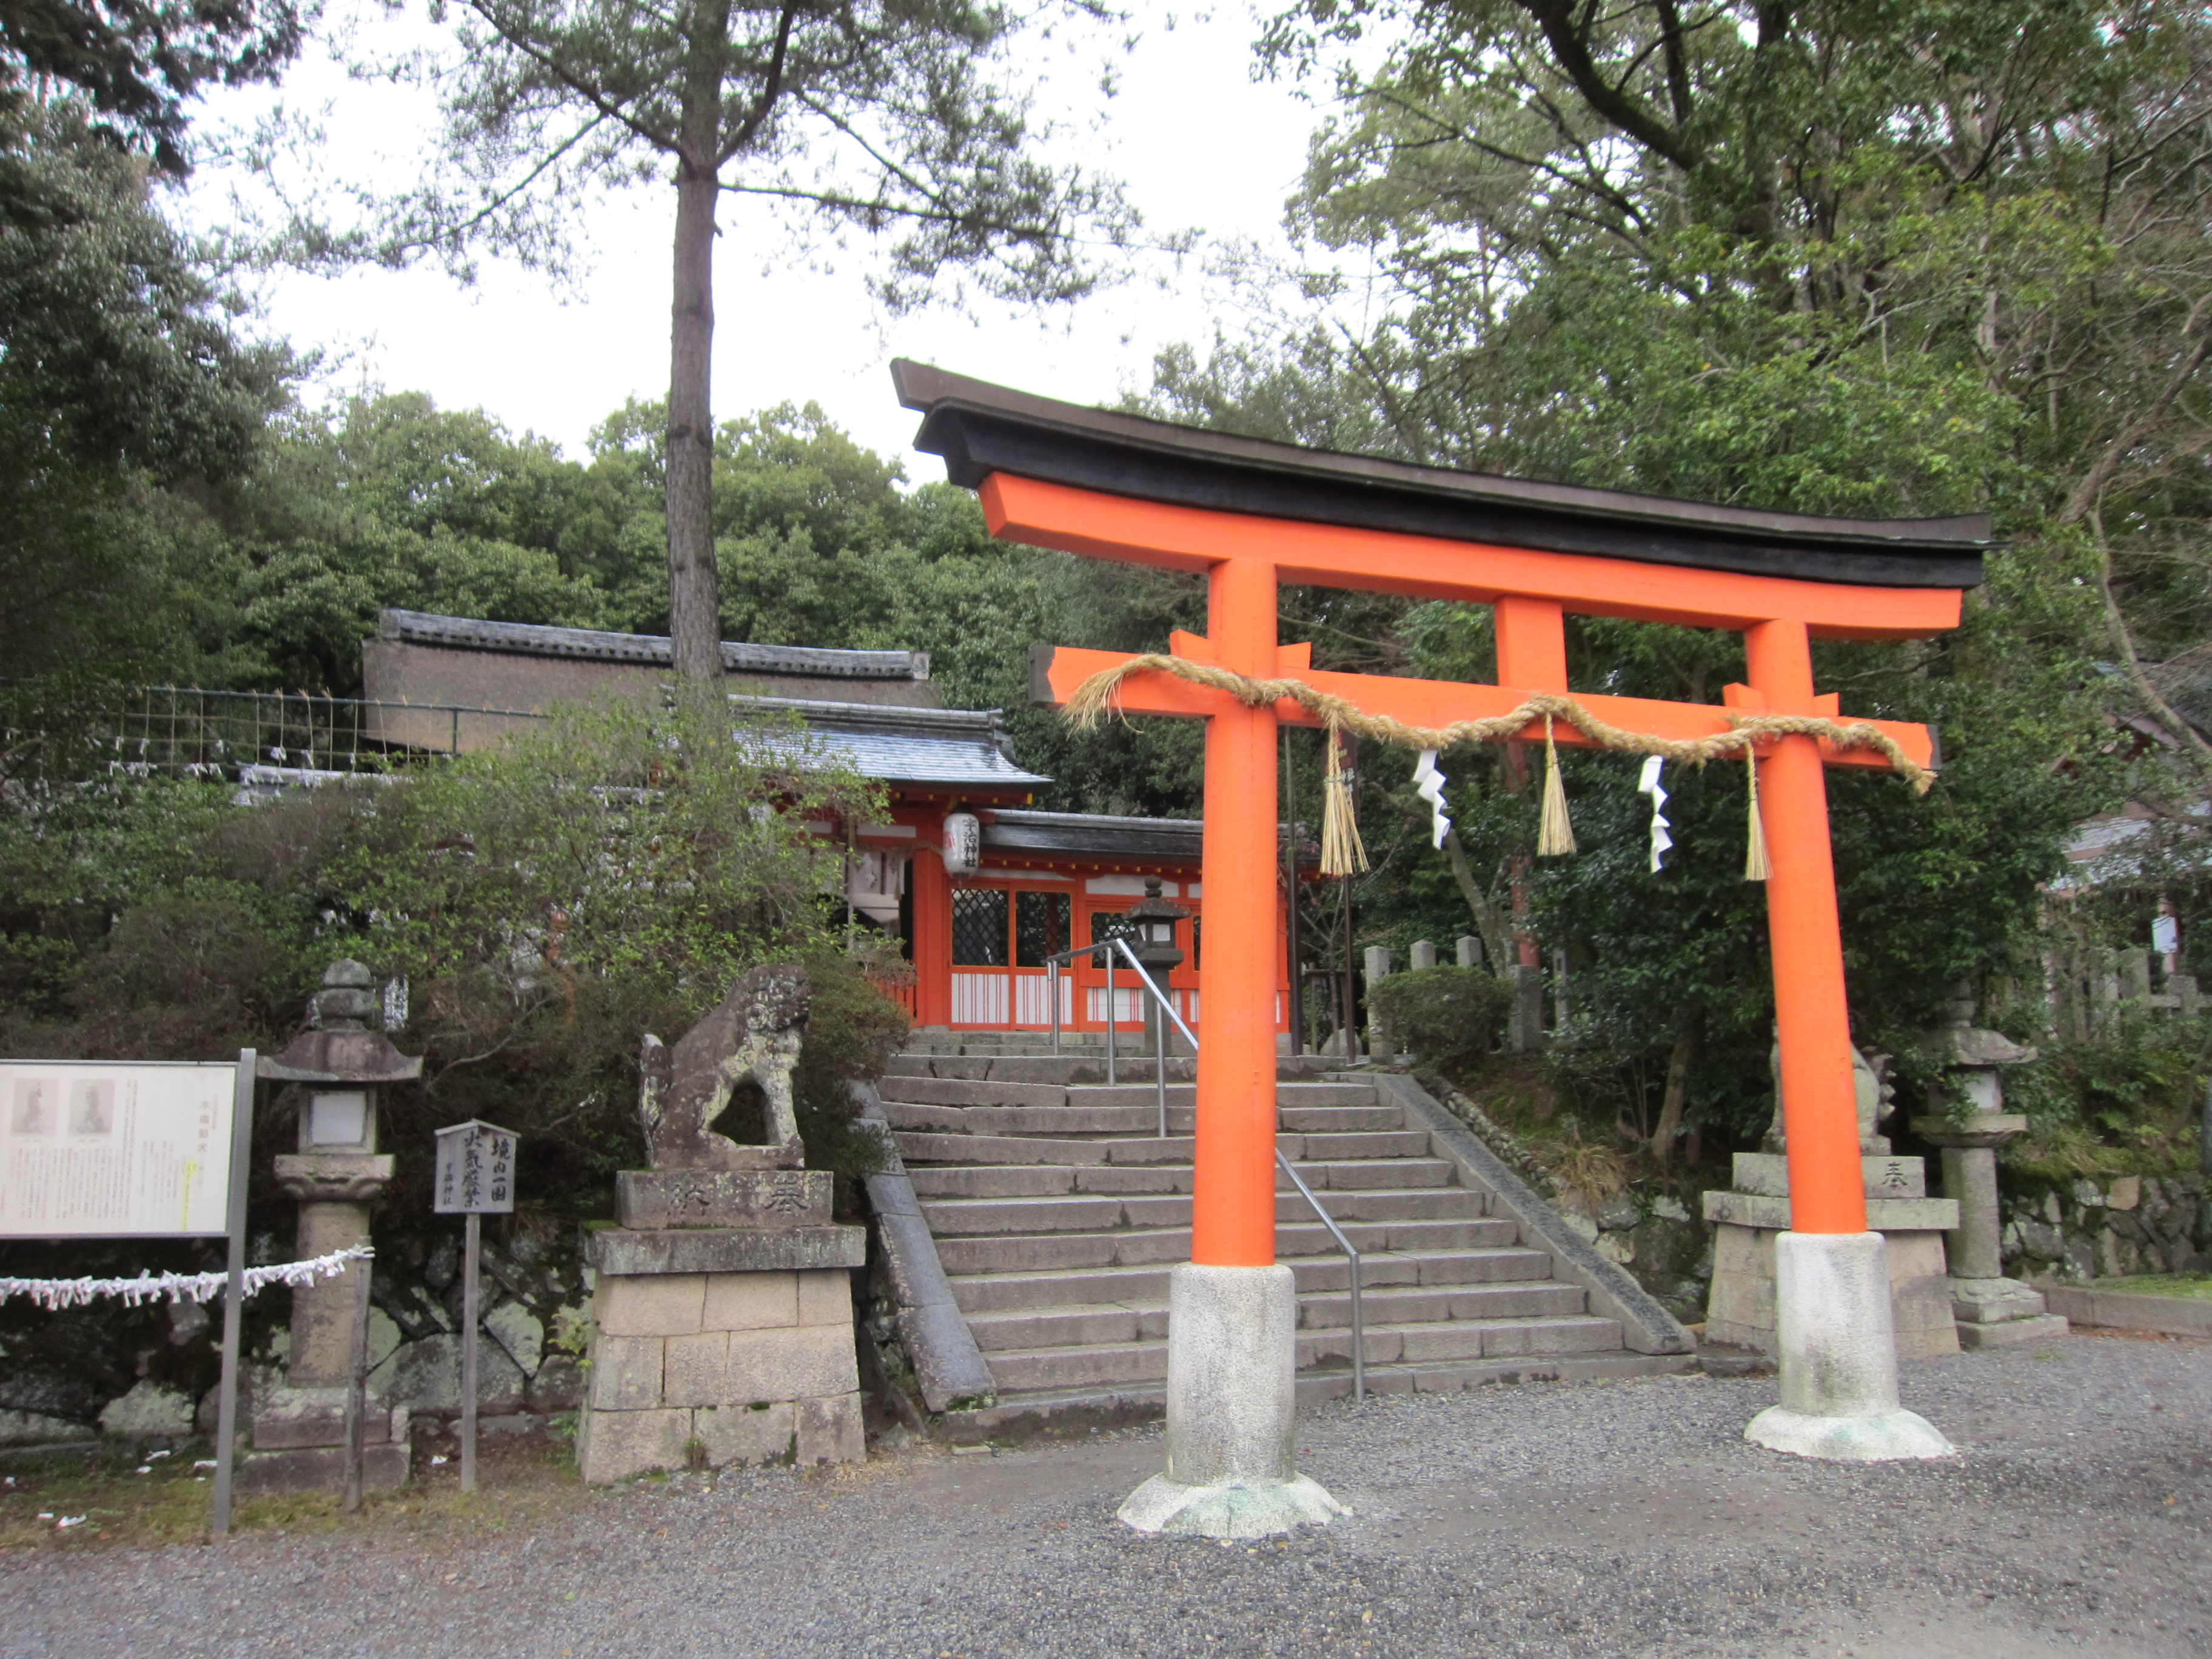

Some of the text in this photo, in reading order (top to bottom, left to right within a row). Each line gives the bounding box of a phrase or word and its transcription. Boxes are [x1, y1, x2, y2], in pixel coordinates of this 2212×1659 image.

[962, 817, 977, 868] 宇治神社
[1882, 1161, 1908, 1191] 奉
